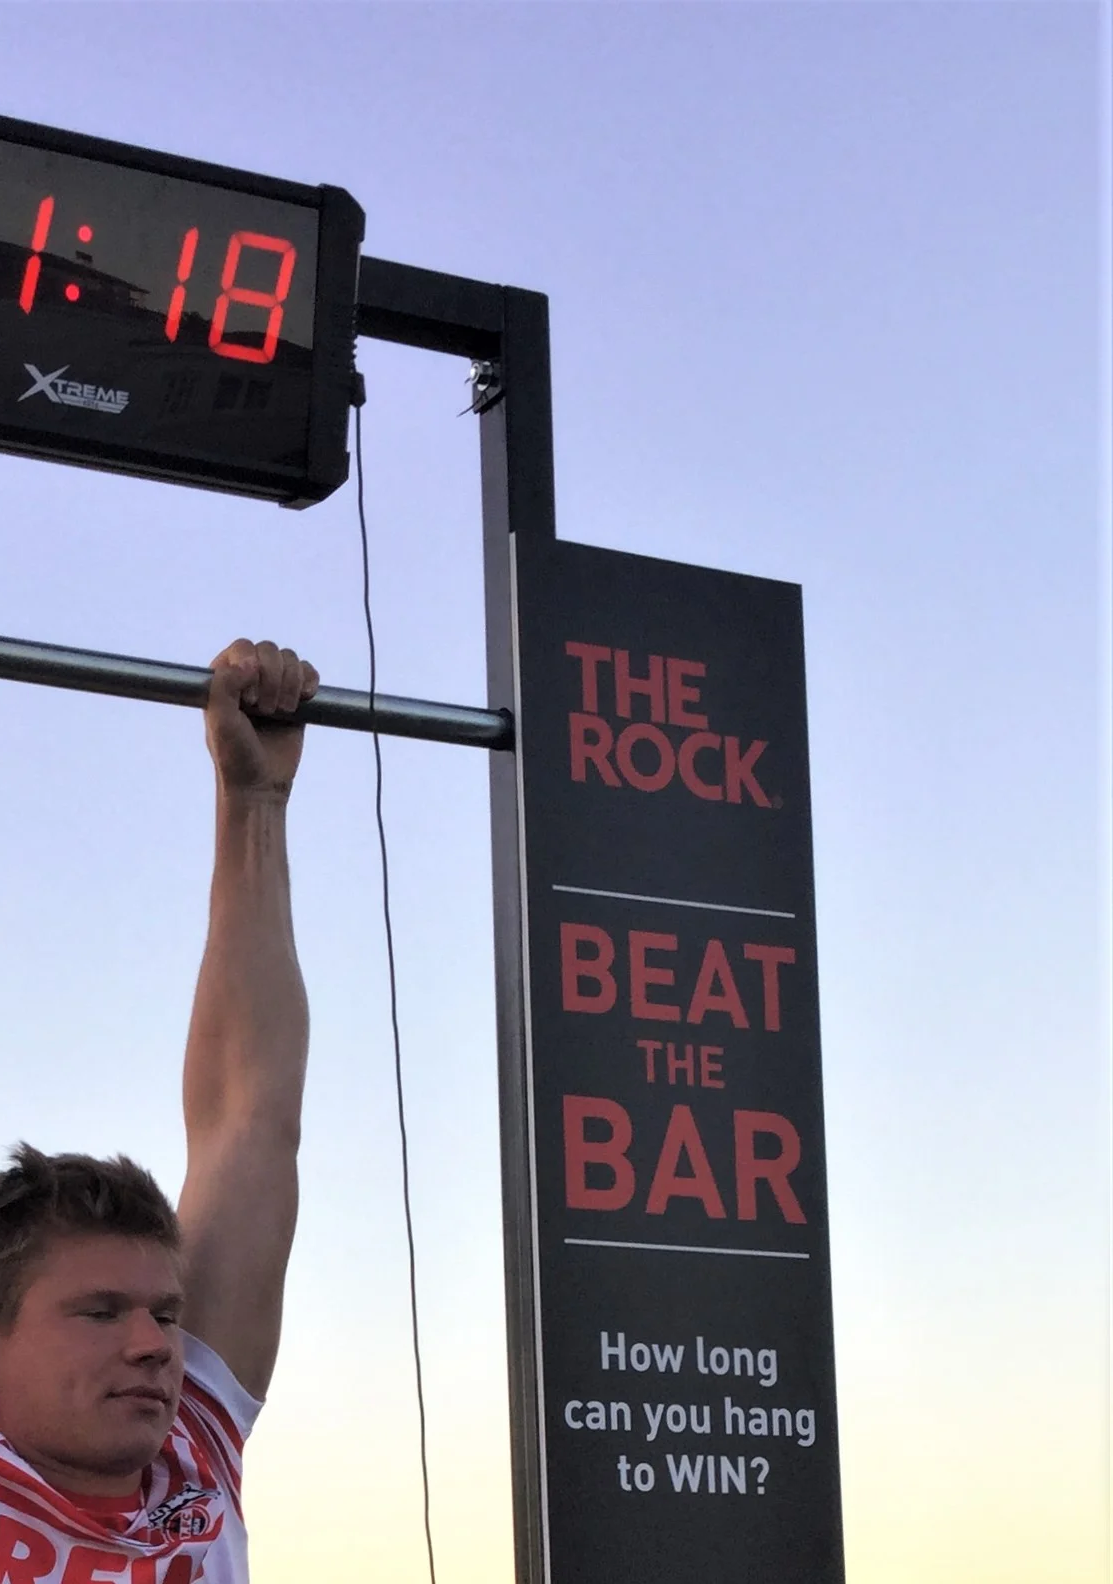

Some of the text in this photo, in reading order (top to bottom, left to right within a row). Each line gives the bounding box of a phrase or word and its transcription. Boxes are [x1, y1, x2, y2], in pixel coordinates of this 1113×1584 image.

[17, 363, 130, 407] XTREME
[565, 641, 709, 730] THE
[569, 711, 773, 808] ROCK
[560, 922, 796, 1032] BEAT
[638, 1039, 726, 1089] THE
[563, 1094, 808, 1225] BAR
[600, 1331, 778, 1387] How long
[564, 1396, 816, 1447] can you hang
[617, 1453, 770, 1495] to WIN?
